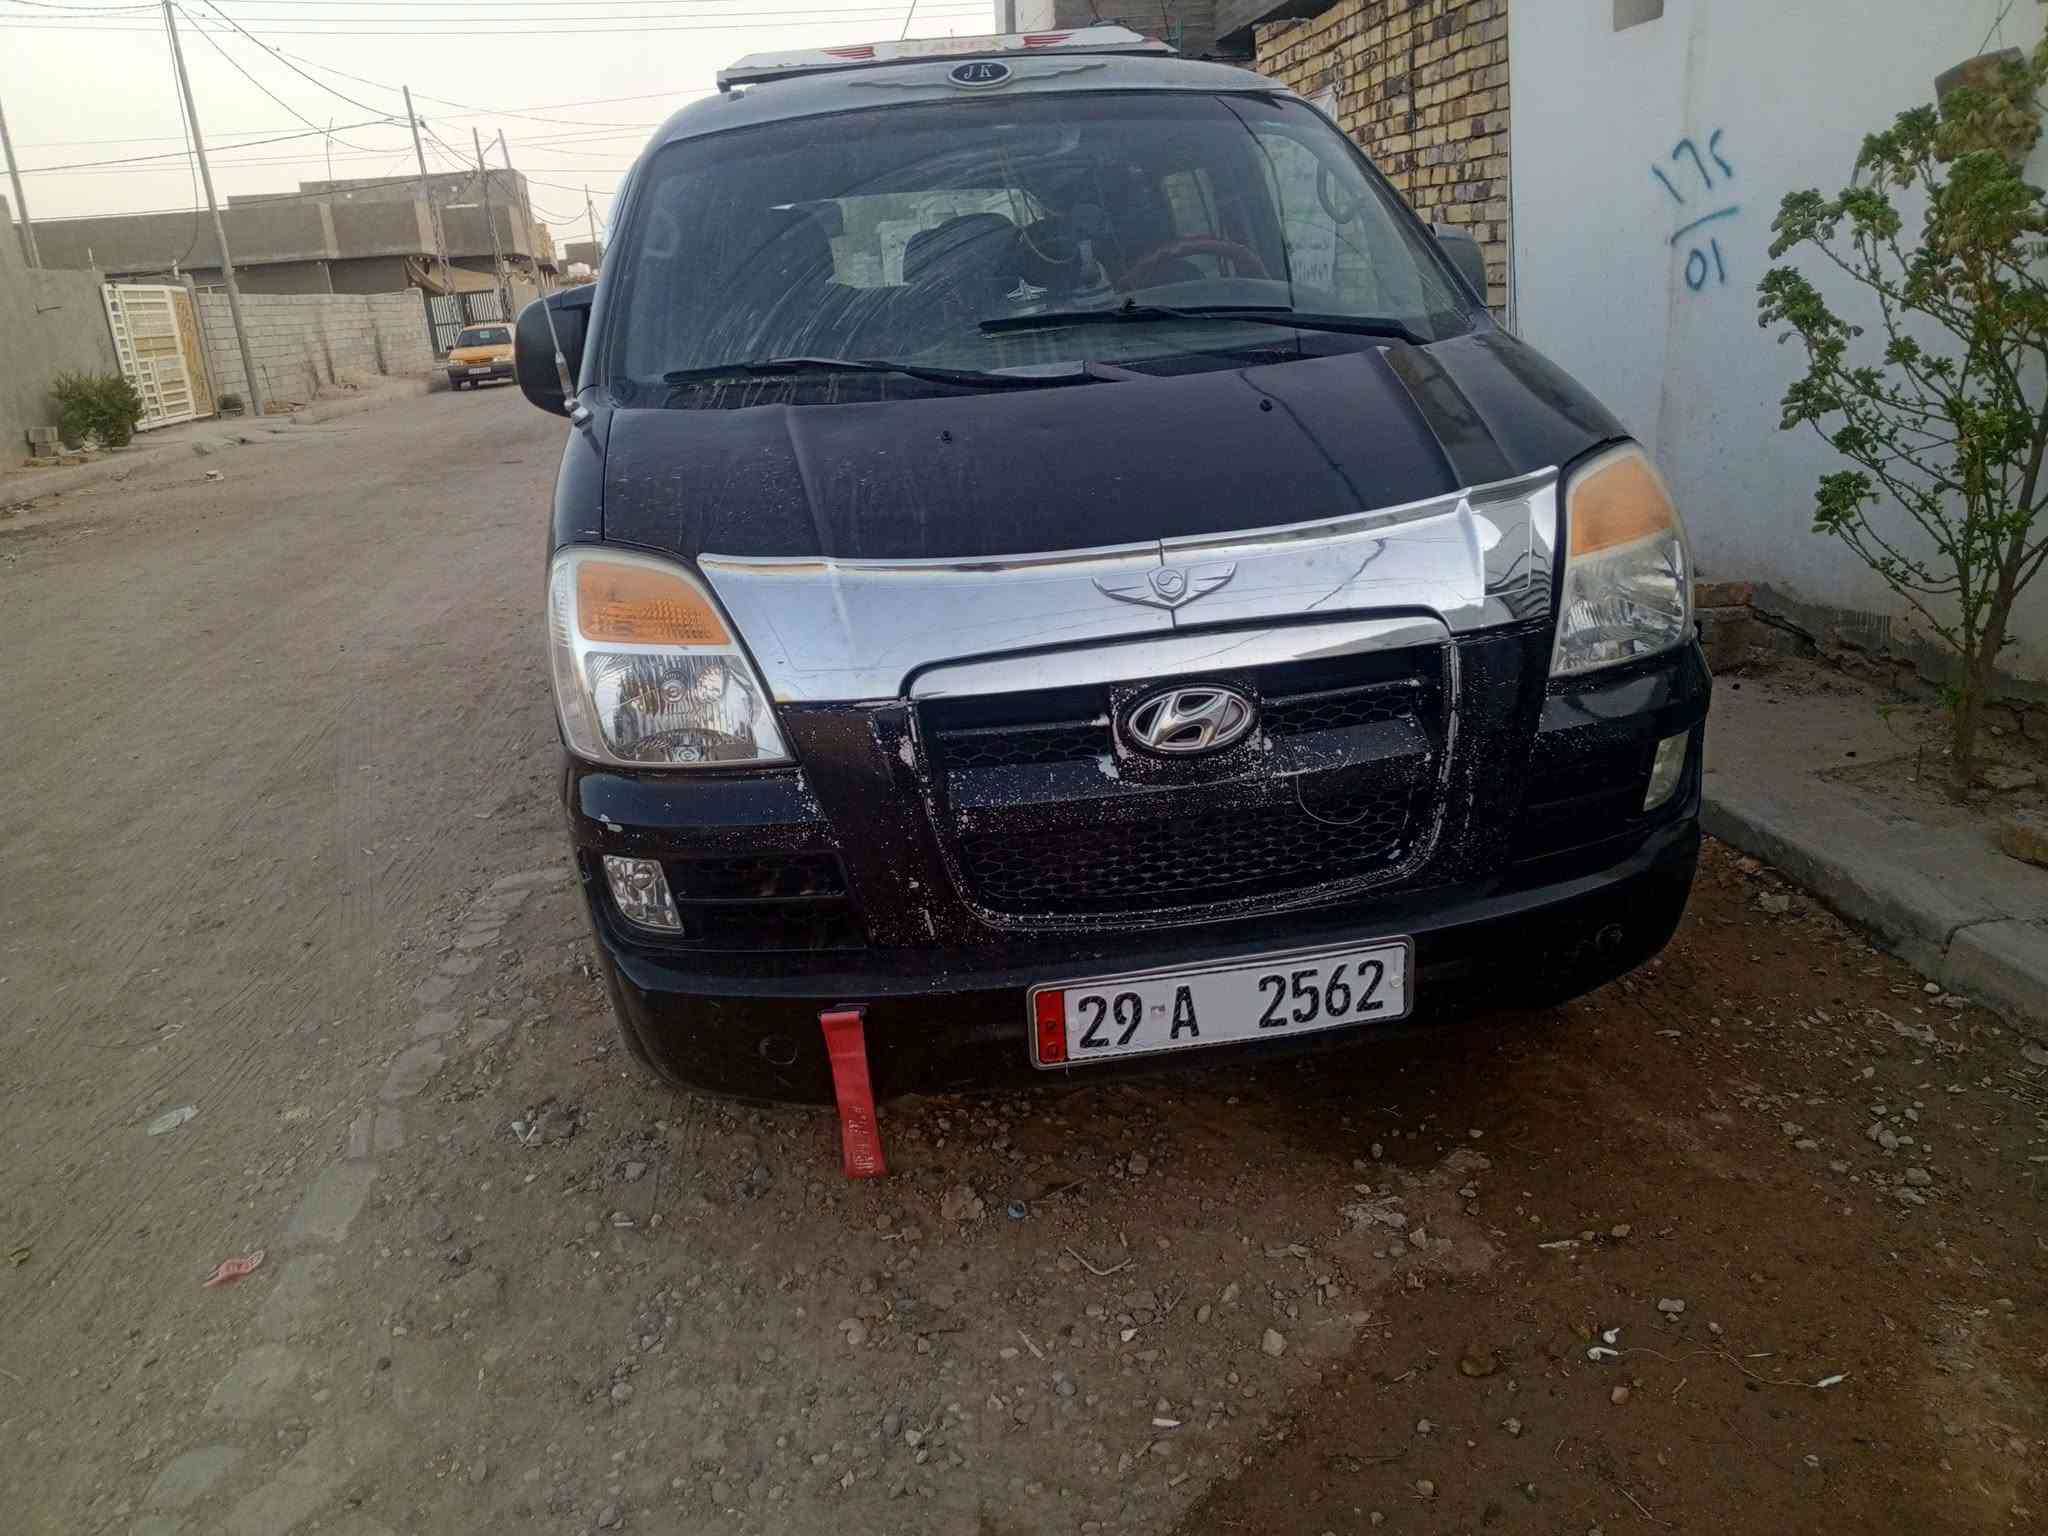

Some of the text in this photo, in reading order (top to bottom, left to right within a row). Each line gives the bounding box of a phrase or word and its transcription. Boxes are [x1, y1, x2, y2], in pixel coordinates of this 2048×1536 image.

[1078, 992, 1143, 1048] 29
[1169, 985, 1200, 1040] A
[1257, 959, 1384, 1029] 2562
